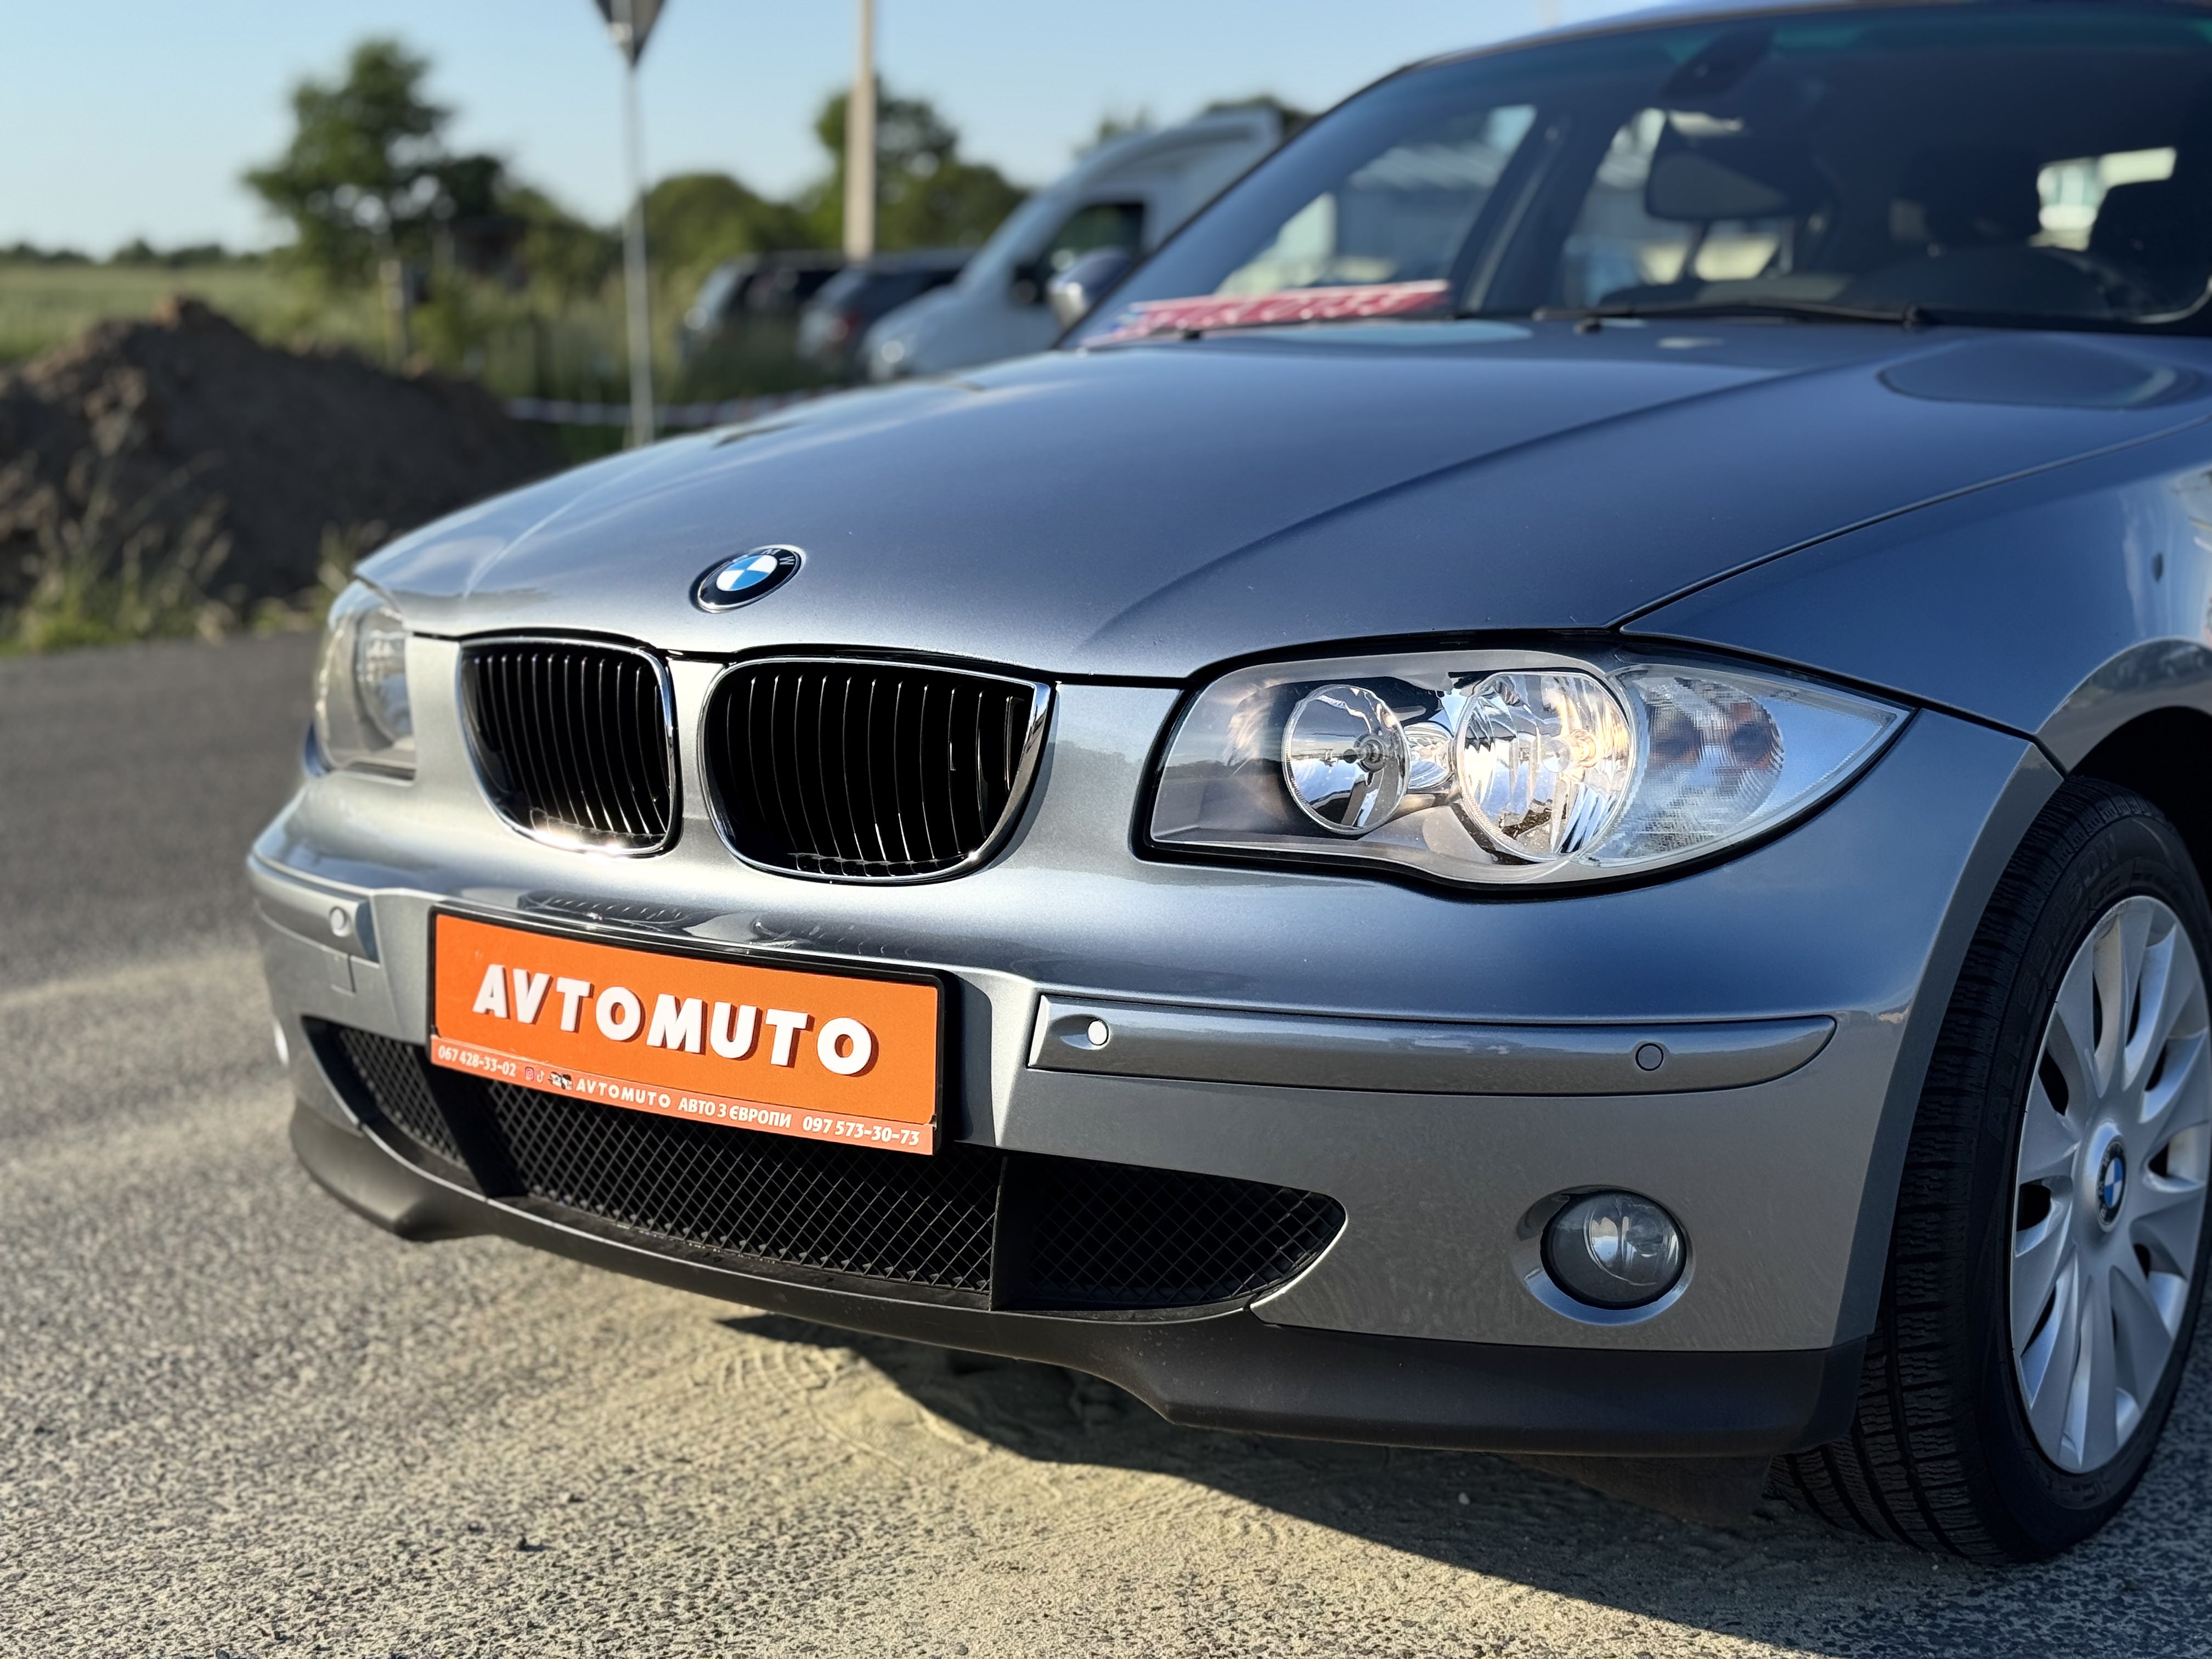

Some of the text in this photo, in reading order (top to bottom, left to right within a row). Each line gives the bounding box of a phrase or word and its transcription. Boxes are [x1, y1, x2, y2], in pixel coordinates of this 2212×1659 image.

[732, 549, 795, 565] MW
[472, 964, 877, 1076] AVTOMUTO
[438, 1045, 516, 1077] 067 428-33-02
[576, 1079, 671, 1108] AVTOMUTO
[678, 1097, 715, 1116] АВТО
[729, 1105, 792, 1128] ЄВРОПИ
[803, 1116, 920, 1146] 097 573-30-73
